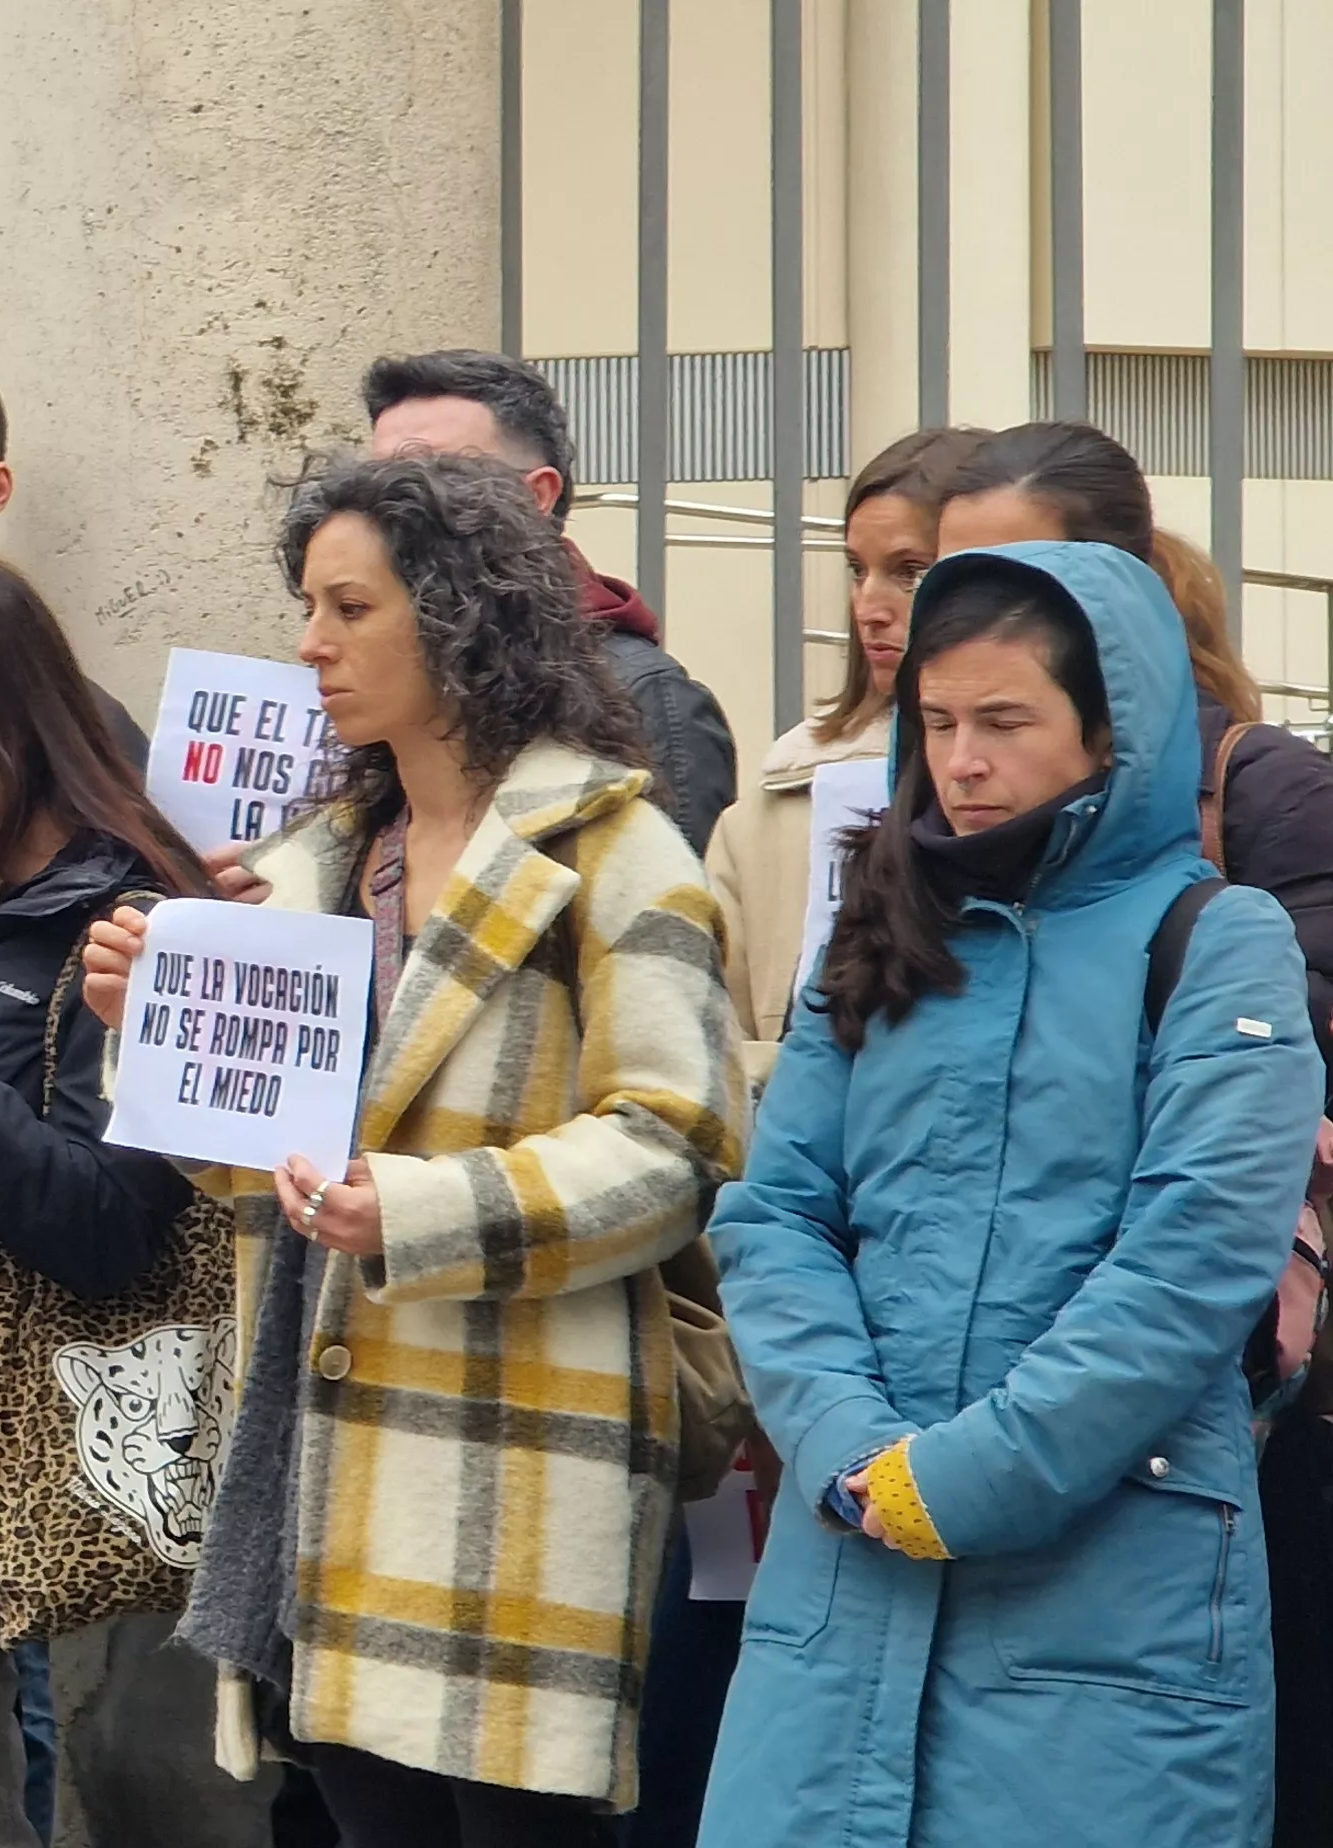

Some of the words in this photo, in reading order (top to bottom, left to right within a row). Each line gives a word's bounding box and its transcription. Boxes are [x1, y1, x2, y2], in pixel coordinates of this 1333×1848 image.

[188, 690, 247, 737] QUE
[254, 700, 288, 743] EL
[182, 740, 224, 785] NO
[233, 747, 294, 795] NOS
[230, 798, 264, 841] LA
[153, 951, 194, 997] QUE
[200, 957, 225, 1002] LA
[233, 964, 340, 1019] VOCACIÓN
[139, 1002, 170, 1046] NO
[175, 1008, 206, 1052] SE
[209, 1012, 289, 1065] ROMPA
[294, 1024, 341, 1073] POR
[177, 1062, 203, 1106] EL
[209, 1066, 283, 1118] MIEDO
